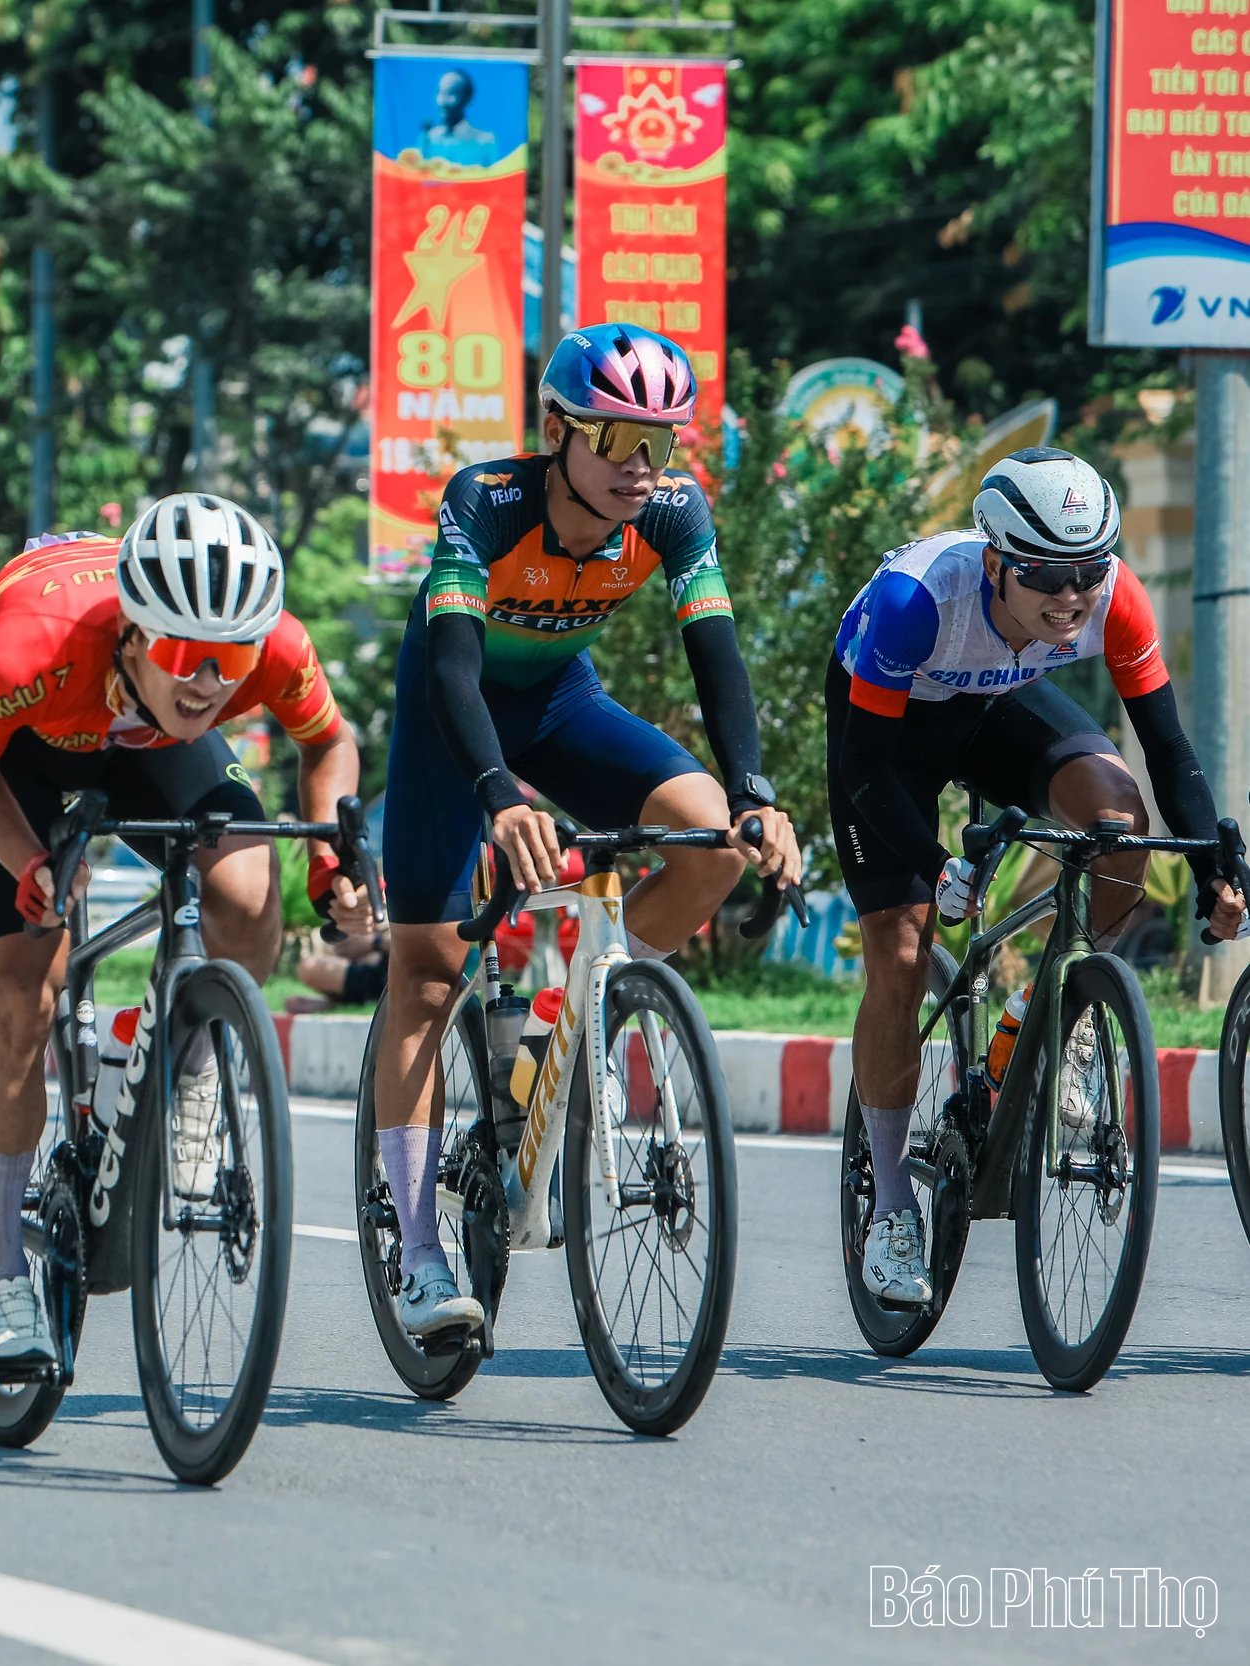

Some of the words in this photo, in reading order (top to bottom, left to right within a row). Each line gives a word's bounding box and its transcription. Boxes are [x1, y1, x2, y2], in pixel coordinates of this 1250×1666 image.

[1192, 27, 1236, 55] CÁC
[1199, 296, 1250, 318] VN
[397, 330, 504, 389] 80
[398, 387, 504, 421] NĂM
[602, 581, 635, 589] motive
[434, 594, 487, 613] GARMIN
[495, 596, 622, 614] MAXXI
[690, 598, 730, 612] GARM
[492, 610, 525, 625] LE
[51, 662, 74, 690] 7
[848, 824, 865, 864] MONTON
[870, 1265, 888, 1284] SIDI
